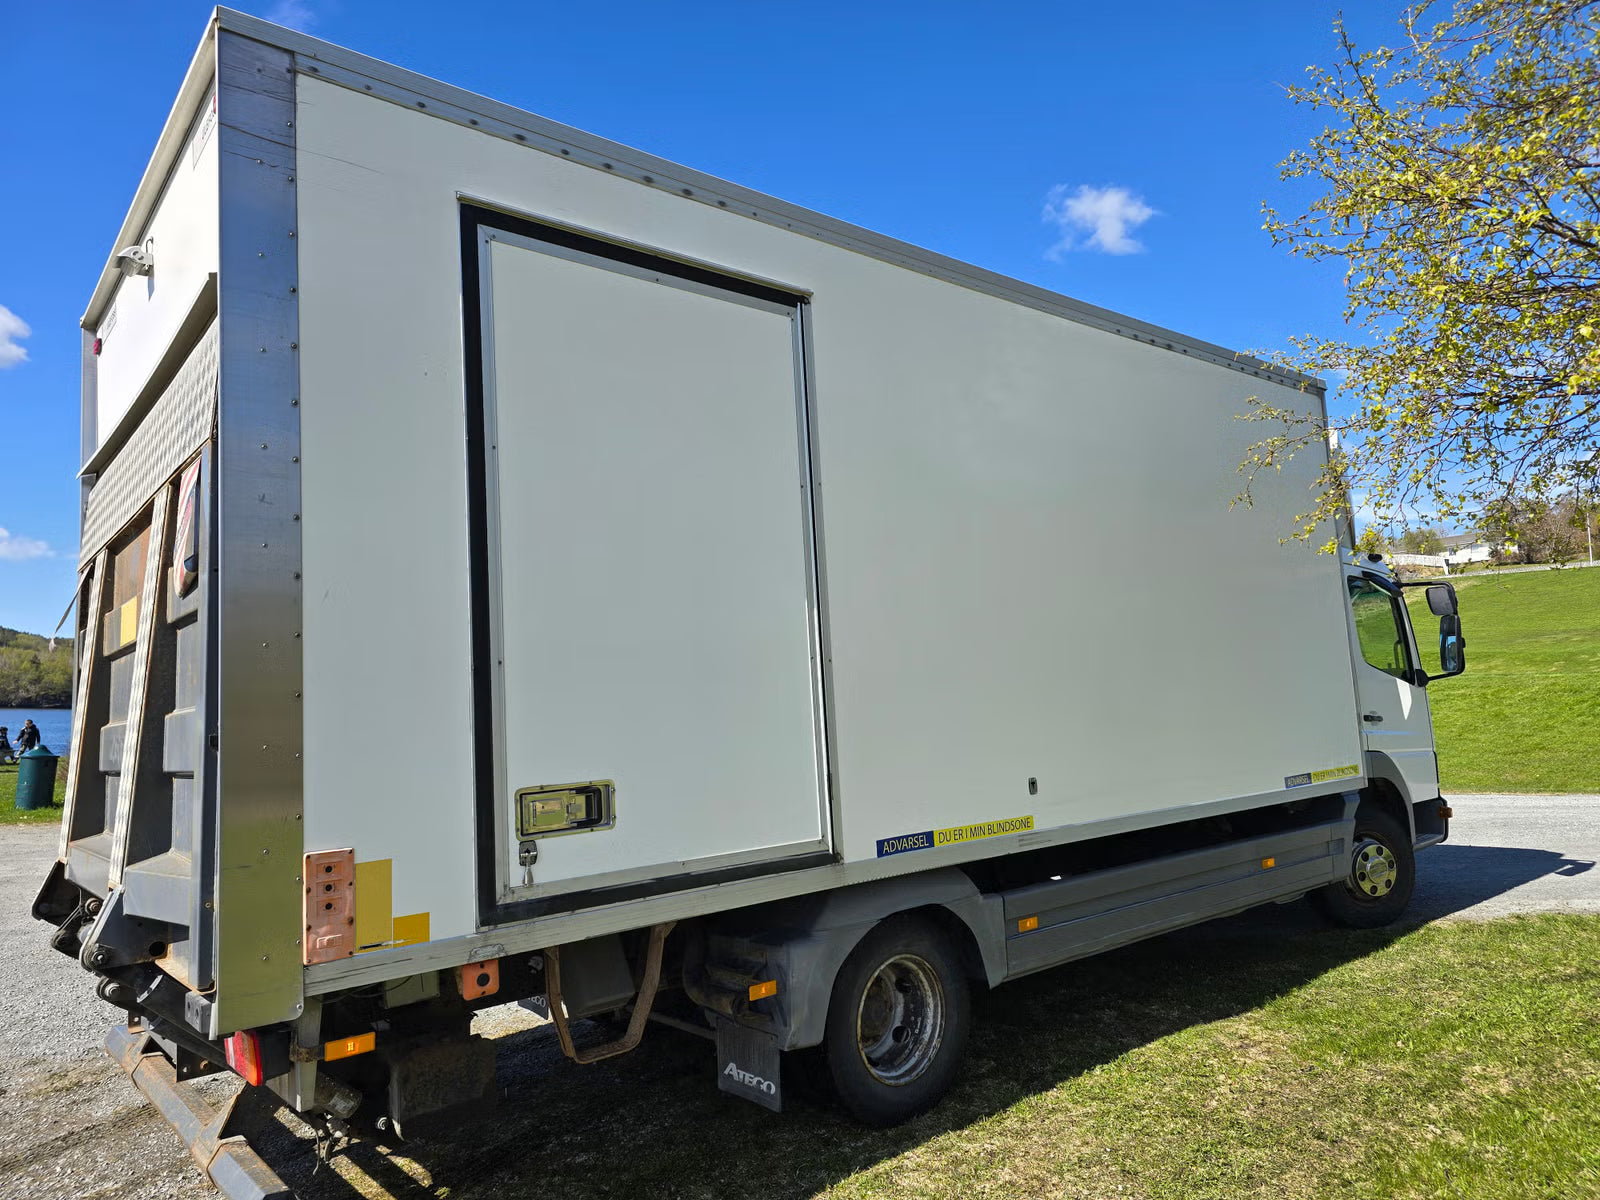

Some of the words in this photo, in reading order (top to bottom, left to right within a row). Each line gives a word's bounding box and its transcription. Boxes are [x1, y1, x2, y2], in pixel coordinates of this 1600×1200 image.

[882, 834, 929, 855] ADVARSEL
[938, 831, 952, 844] DU
[953, 829, 964, 841] ER
[969, 825, 986, 838] MIN
[987, 817, 1031, 836] BLINDSONE
[723, 1062, 776, 1095] ATEGO
